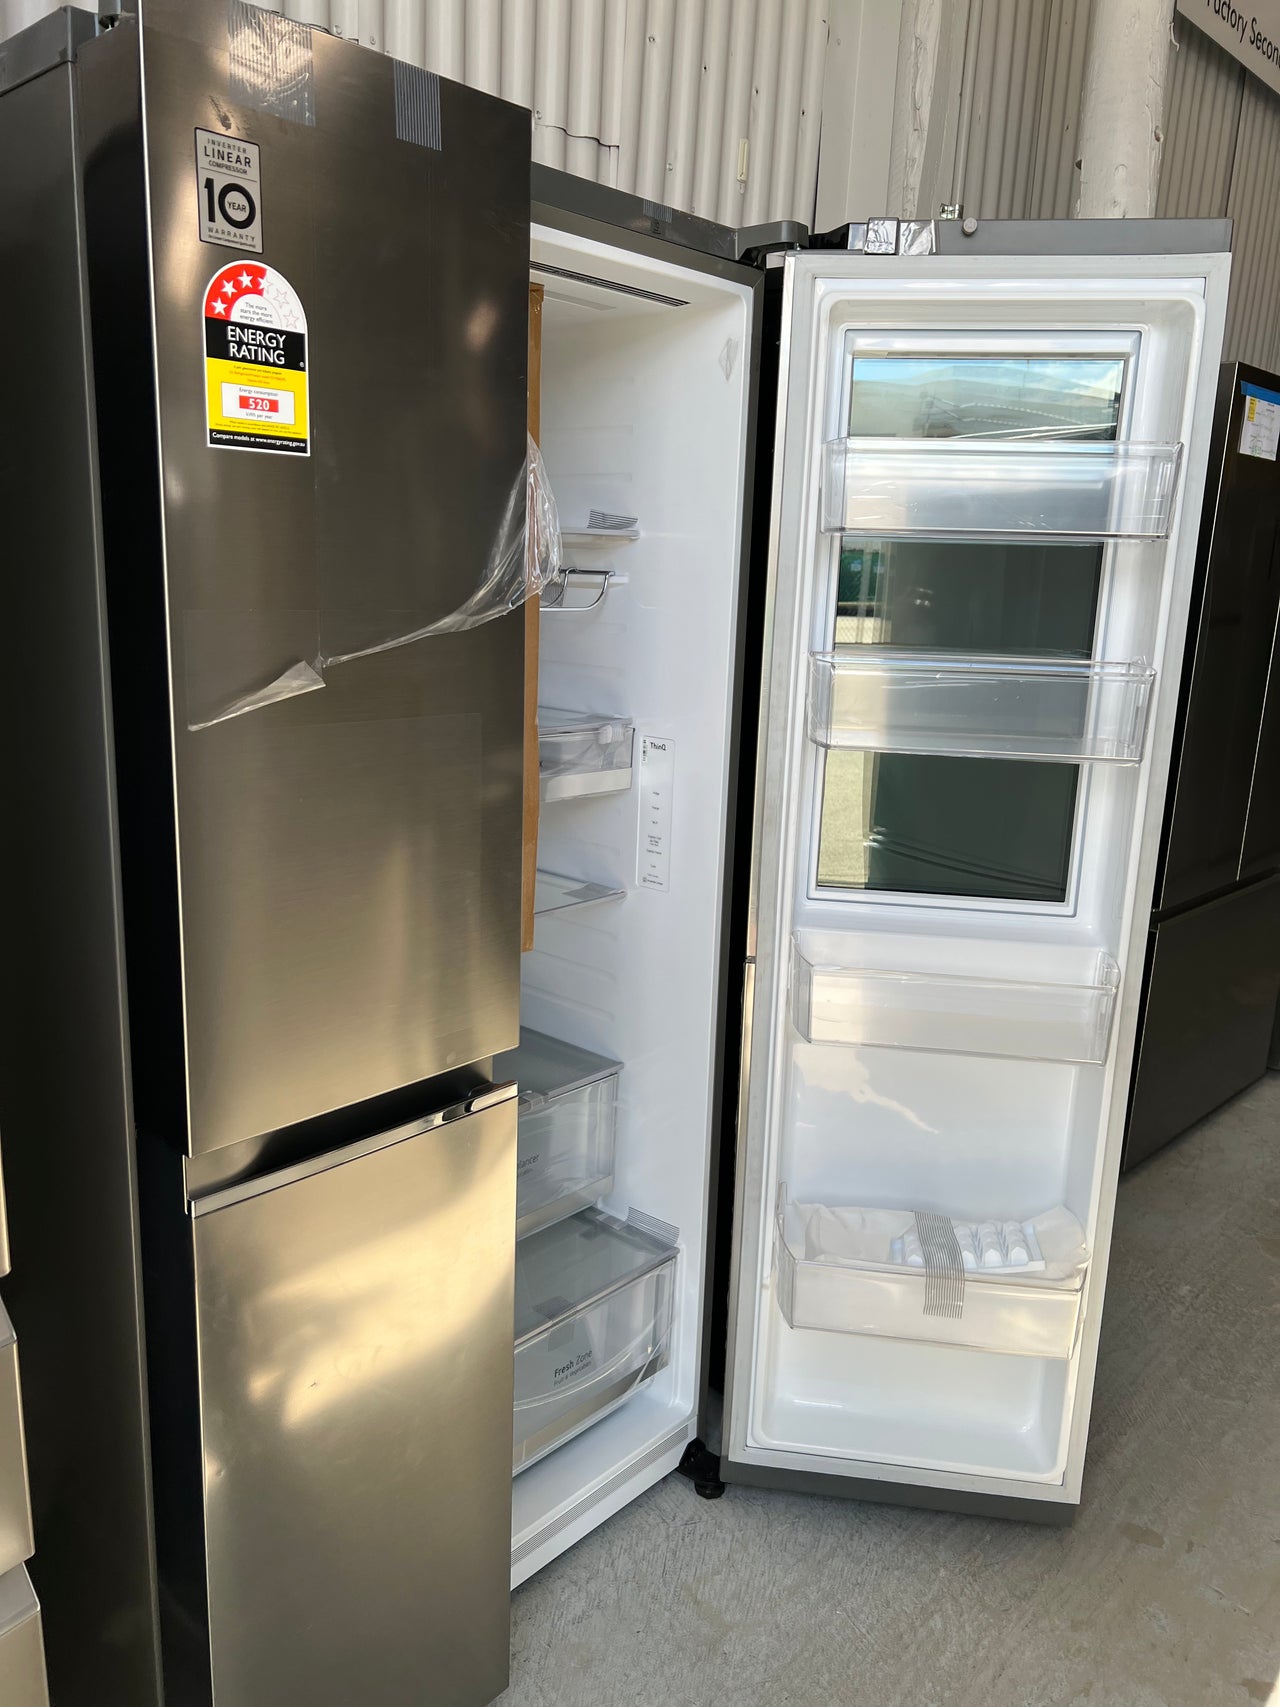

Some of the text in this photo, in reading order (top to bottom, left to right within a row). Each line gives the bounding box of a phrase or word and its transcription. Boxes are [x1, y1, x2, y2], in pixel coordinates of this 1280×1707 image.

[1250, 17, 1280, 69] Secon
[207, 138, 247, 154] INVERTER
[204, 146, 252, 168] LINEAR
[208, 160, 248, 175] COMPRESSOR
[204, 177, 256, 230] 10
[227, 201, 247, 212] YEAR
[207, 226, 256, 243] WARRANTY
[227, 325, 286, 349] ENERGY
[230, 343, 285, 365] RATING
[249, 398, 270, 410] 520
[212, 432, 233, 440] Compare
[650, 741, 667, 751] ThinQ
[554, 1350, 593, 1378] Fresh Zone
